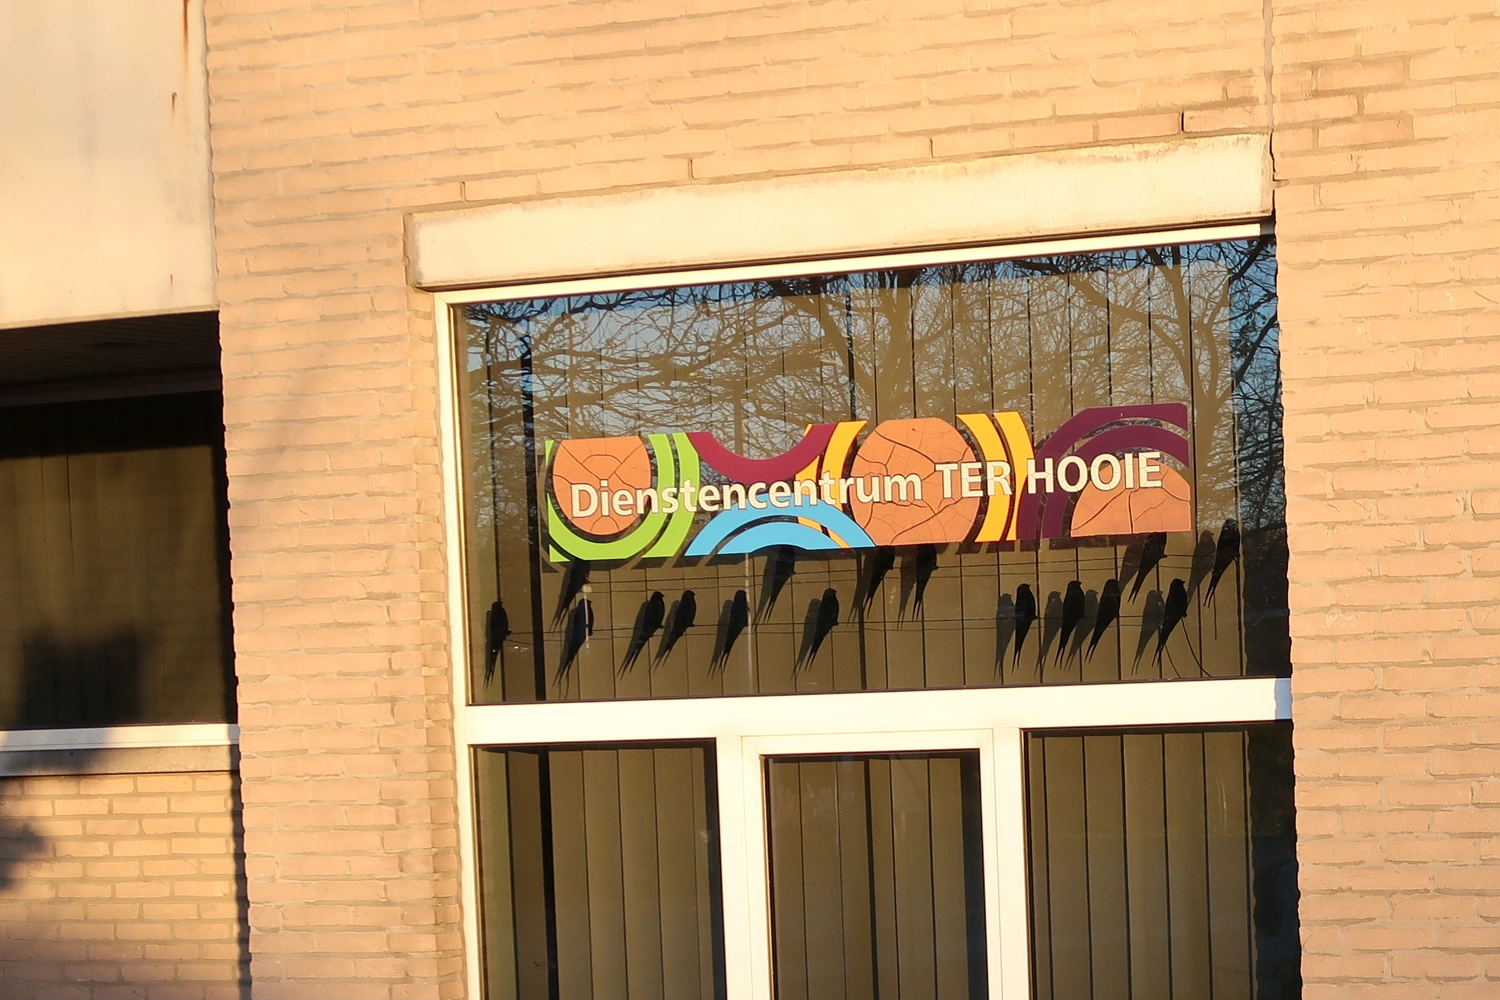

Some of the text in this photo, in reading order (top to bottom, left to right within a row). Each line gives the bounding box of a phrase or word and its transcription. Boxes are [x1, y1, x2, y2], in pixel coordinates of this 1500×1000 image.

[571, 452, 1163, 518] Dienstencentrum TER HOOIE
